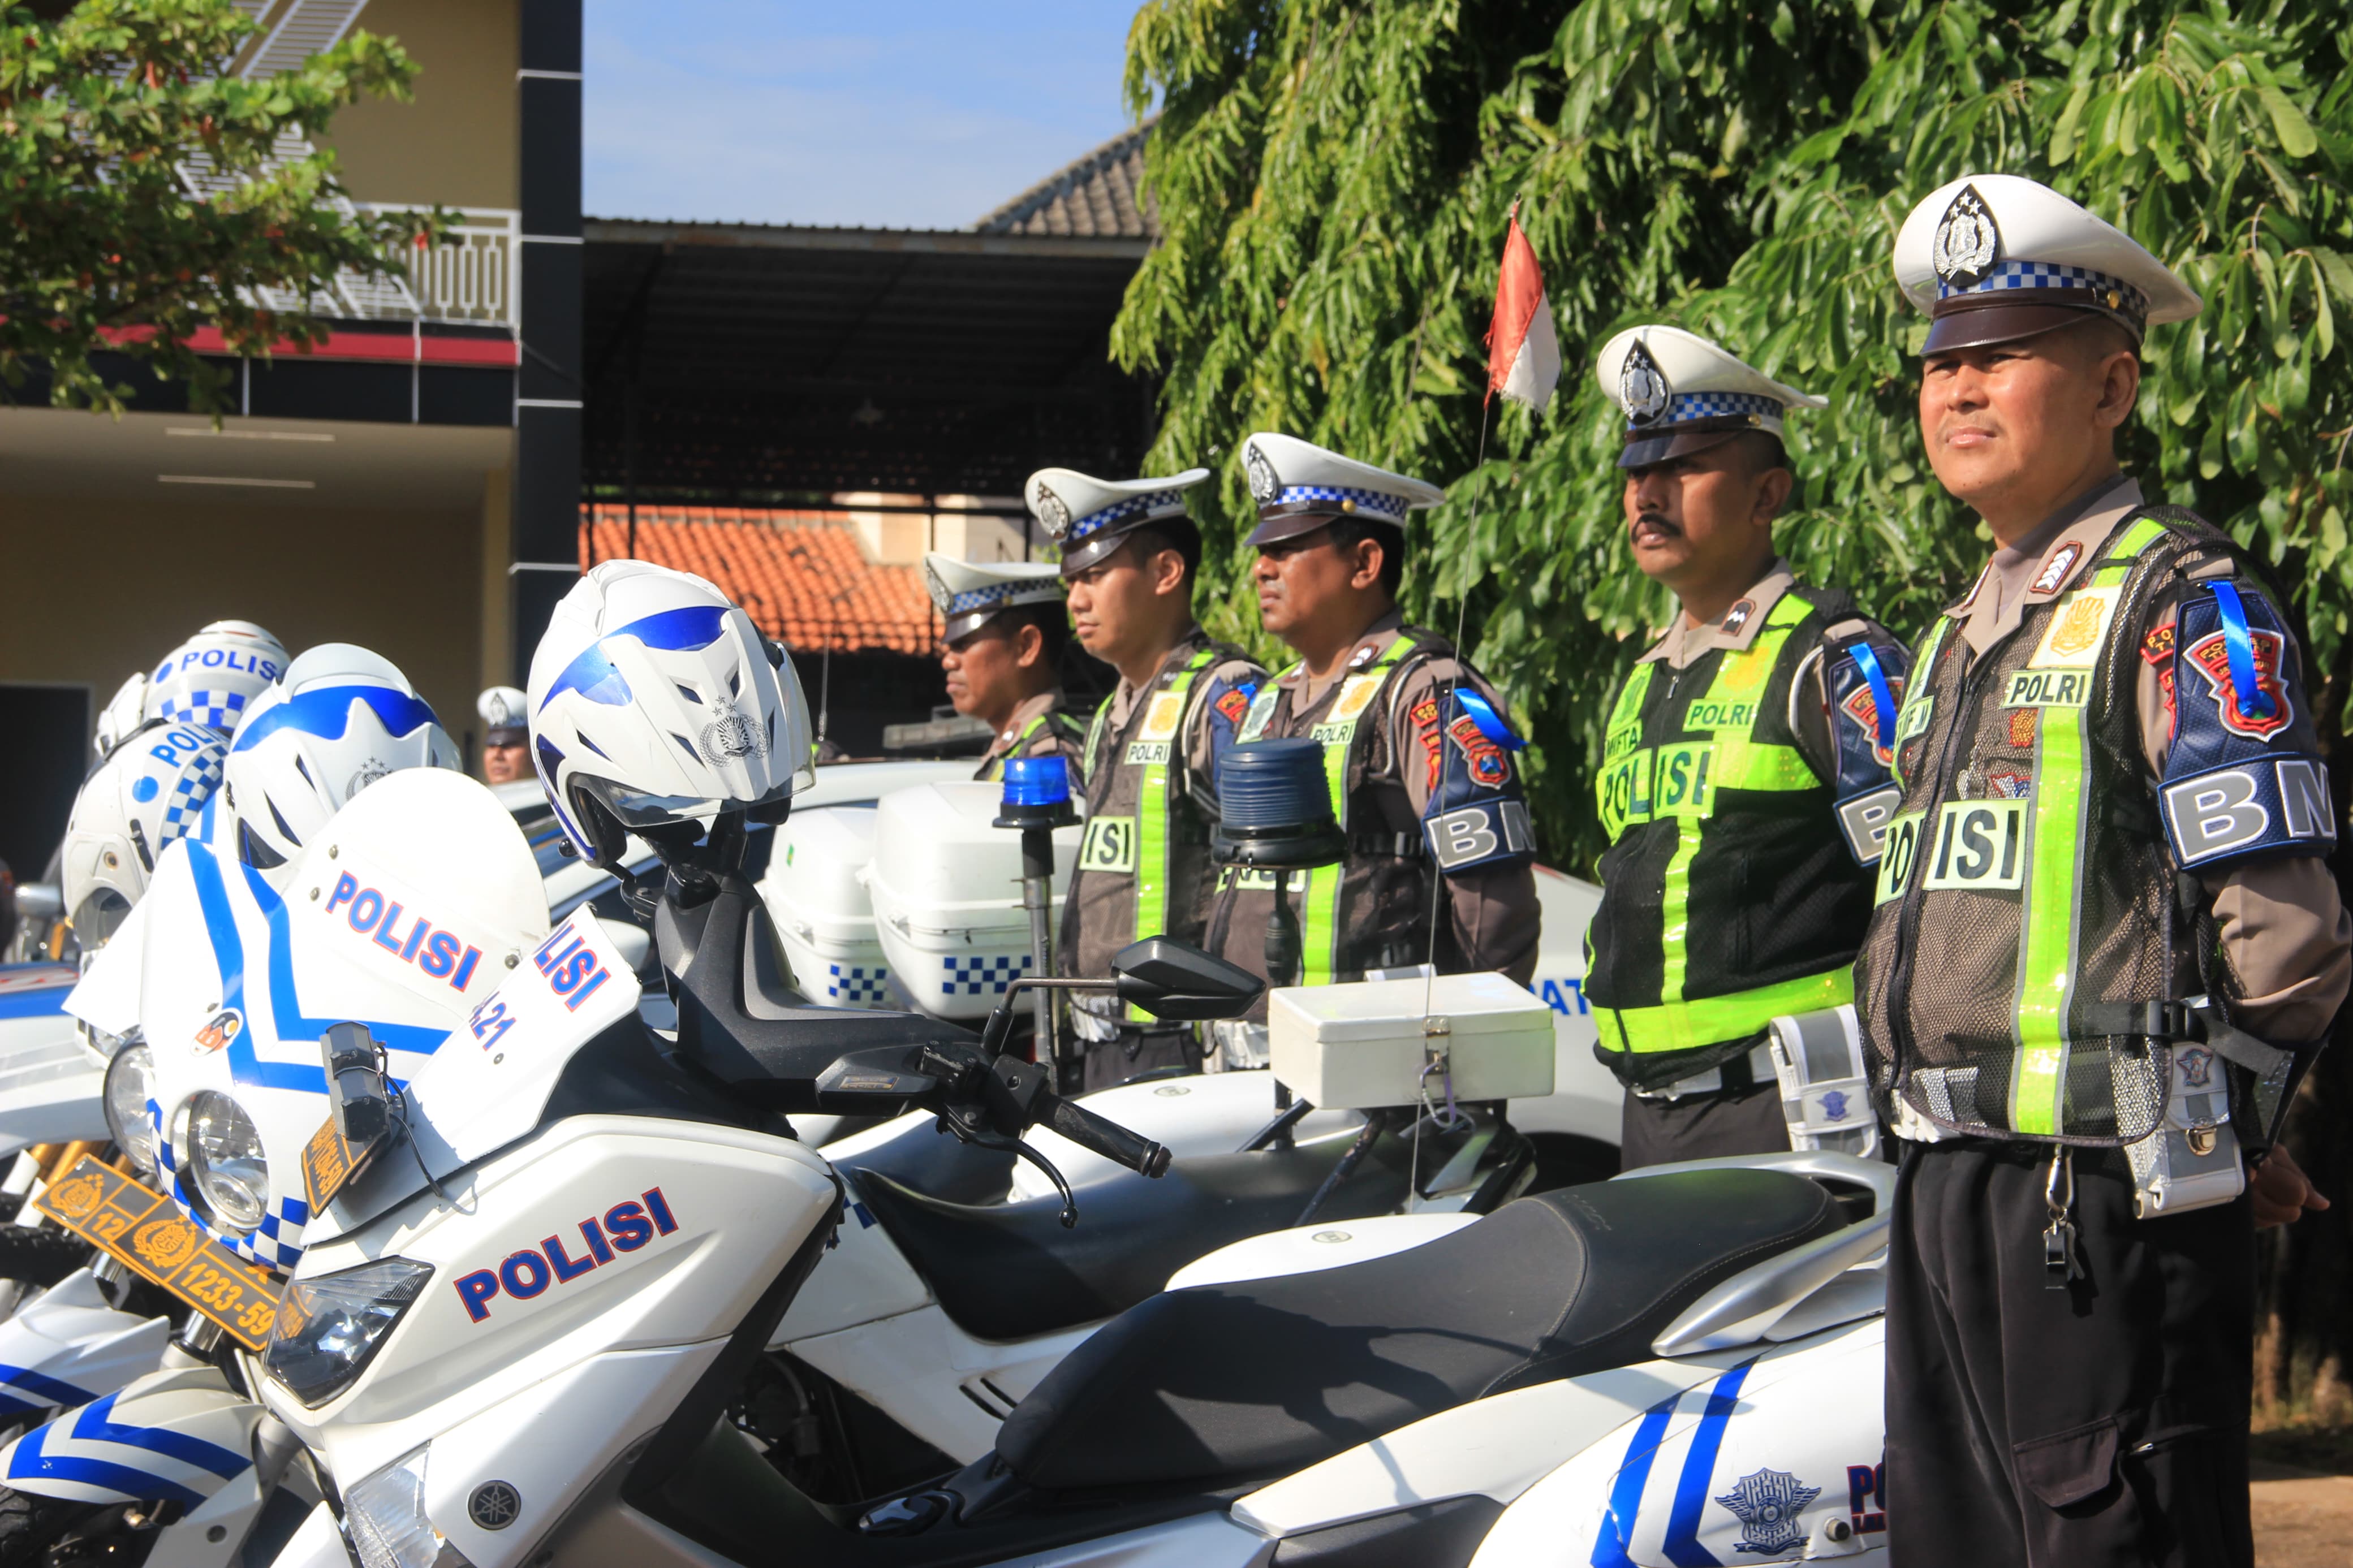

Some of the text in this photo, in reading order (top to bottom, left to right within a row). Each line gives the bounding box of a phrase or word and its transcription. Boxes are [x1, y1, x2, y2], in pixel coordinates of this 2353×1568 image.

[2009, 674, 2086, 704] POLRI
[1313, 724, 1355, 742] POLRI
[1688, 704, 1753, 725] POLRI
[1130, 745, 1169, 761] POLRI
[1085, 822, 1130, 866] ISI
[325, 870, 483, 993] POLISI
[453, 1186, 679, 1324] POLISI
[180, 1262, 275, 1336] 1233-59
